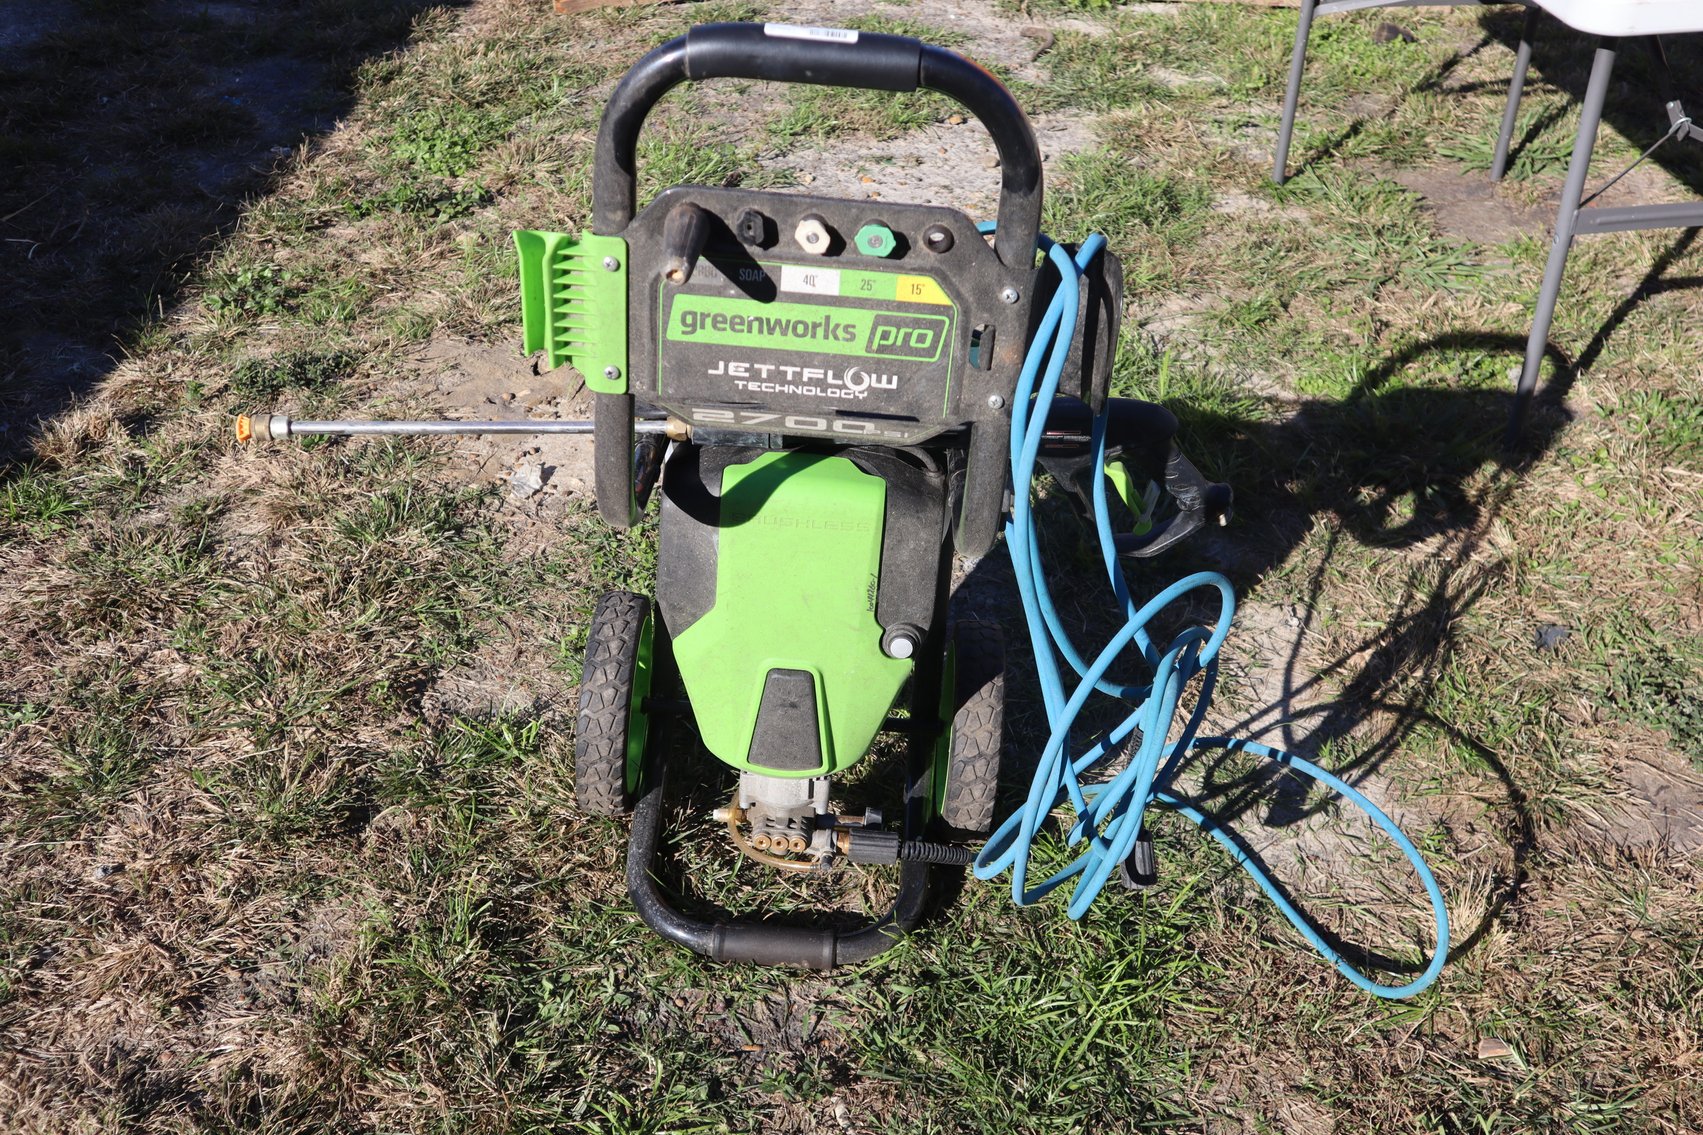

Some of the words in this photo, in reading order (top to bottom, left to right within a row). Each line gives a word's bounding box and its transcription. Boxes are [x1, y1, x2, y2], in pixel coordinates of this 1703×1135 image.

[739, 267, 766, 282] SOAP
[680, 308, 857, 343] greenworks
[873, 325, 934, 352] pro
[707, 360, 898, 391] JETTFLOW
[734, 380, 868, 400] TECHNOLOGY
[691, 407, 875, 434] 2700
